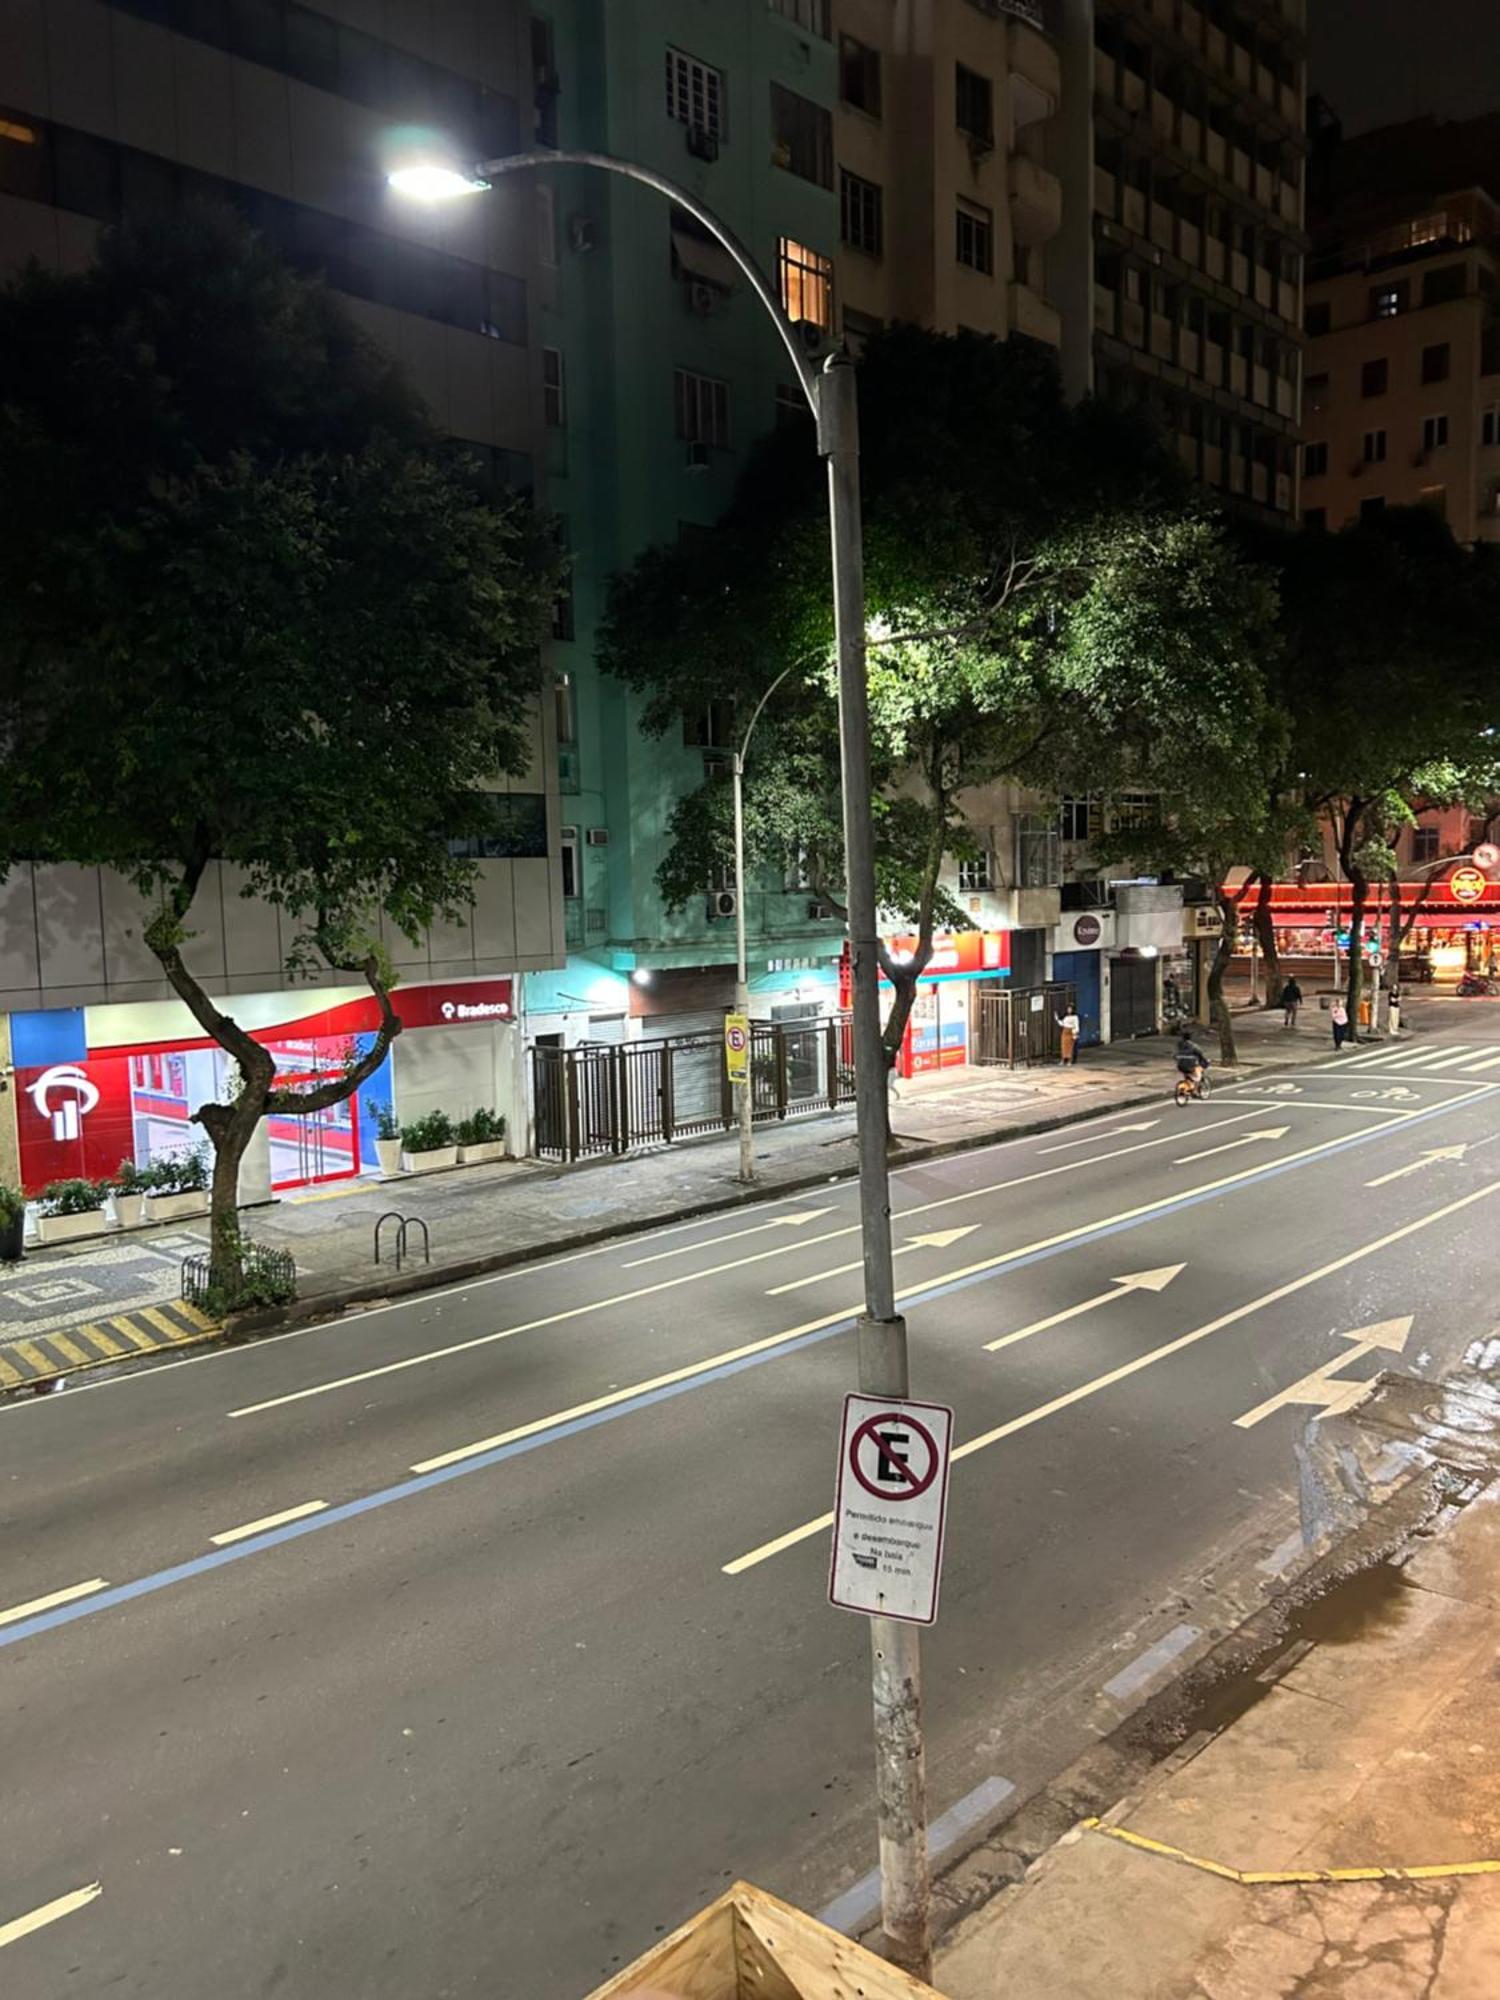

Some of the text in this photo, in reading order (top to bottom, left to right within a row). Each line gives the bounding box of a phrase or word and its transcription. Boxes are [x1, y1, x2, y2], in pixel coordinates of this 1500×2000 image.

[457, 1002, 509, 1018] Bradesco
[877, 1431, 910, 1483] E
[845, 1508, 887, 1524] Permitido
[861, 1532, 921, 1549] desembarque
